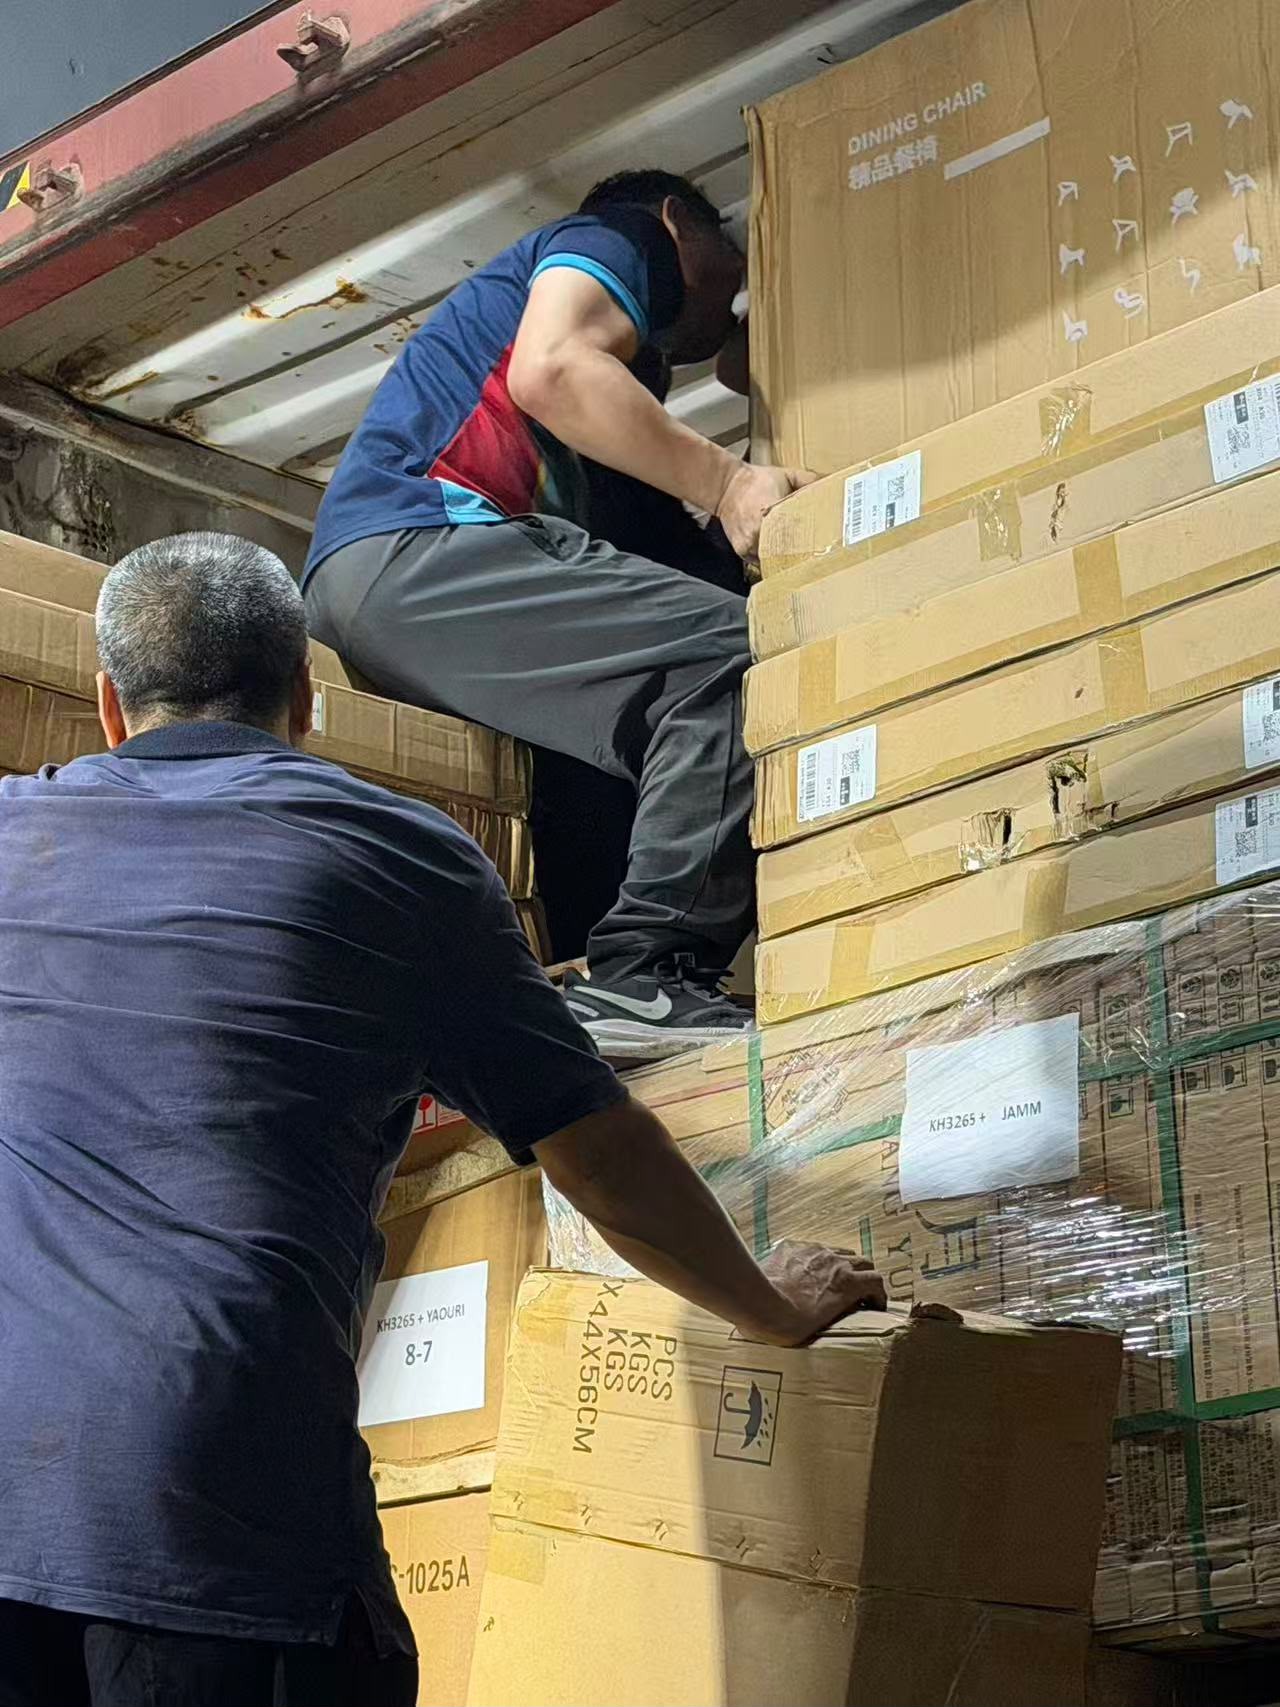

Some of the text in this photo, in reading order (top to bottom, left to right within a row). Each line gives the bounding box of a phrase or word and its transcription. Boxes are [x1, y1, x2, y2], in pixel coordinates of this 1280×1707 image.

[848, 81, 986, 155] DINING CHAIR
[929, 1112, 976, 1133] KH3265
[1001, 1100, 1042, 1121] JAMM
[376, 1313, 416, 1333] KH3265
[426, 1303, 466, 1323] YAOURI
[405, 1340, 433, 1366] 8-7
[603, 1327, 629, 1393] KGS
[628, 1331, 653, 1396] KGS
[651, 1334, 678, 1402] PCS
